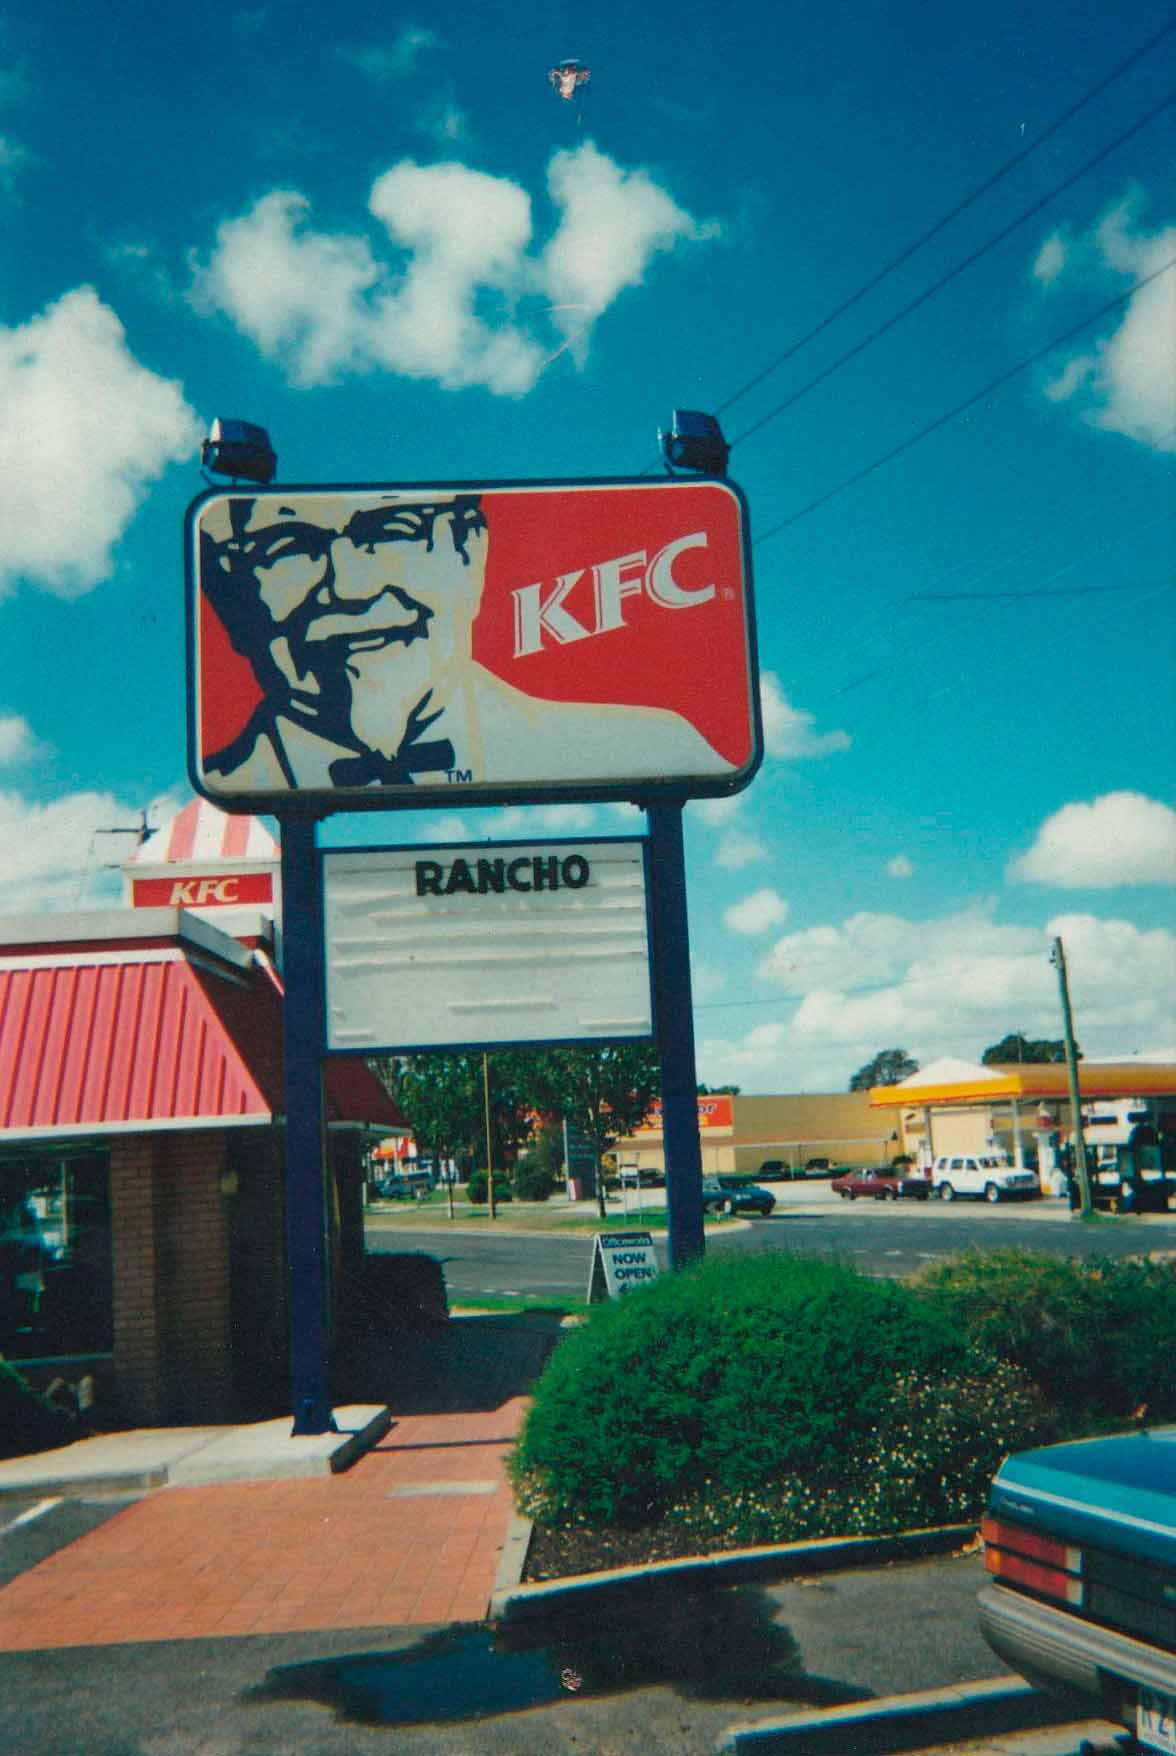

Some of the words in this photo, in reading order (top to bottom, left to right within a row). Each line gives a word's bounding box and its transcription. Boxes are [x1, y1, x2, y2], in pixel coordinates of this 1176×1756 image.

[511, 530, 716, 659] KFC
[446, 769, 473, 783] TM
[415, 854, 590, 896] RANCHO
[169, 878, 239, 905] KFC
[613, 1251, 646, 1265] NOW
[615, 1266, 655, 1280] OPEN
